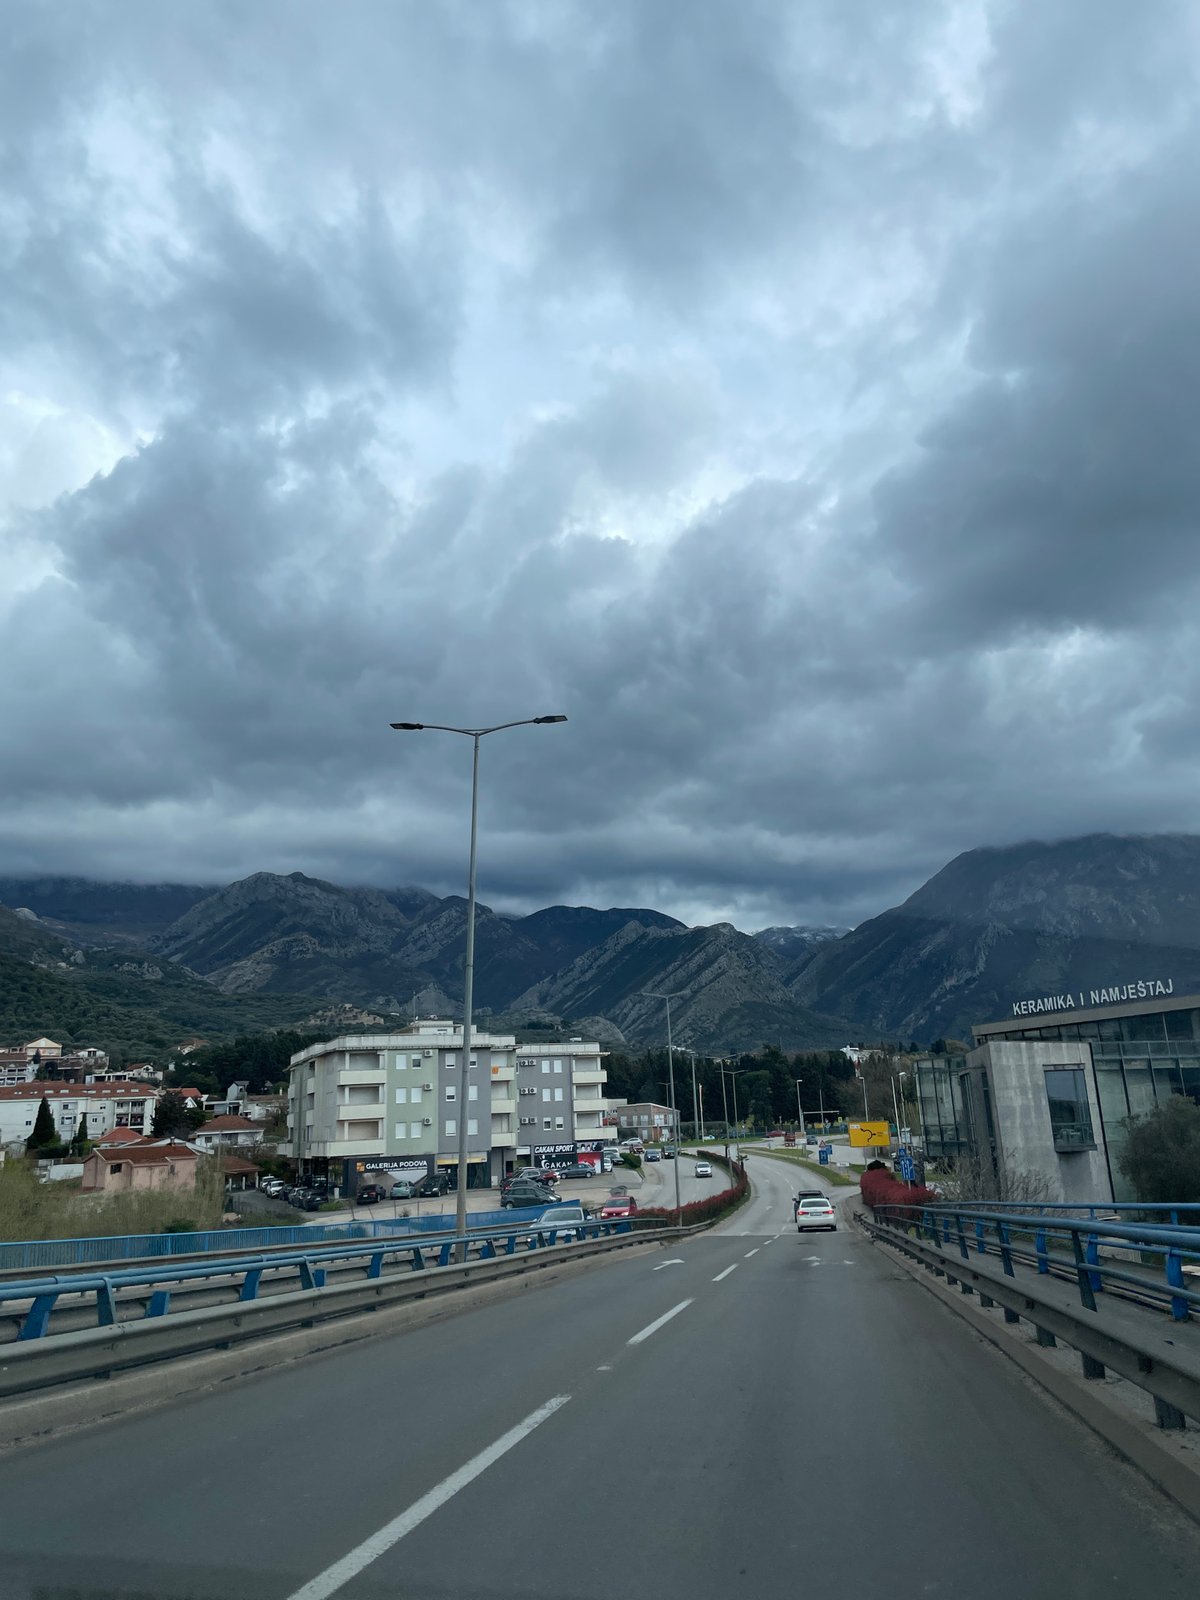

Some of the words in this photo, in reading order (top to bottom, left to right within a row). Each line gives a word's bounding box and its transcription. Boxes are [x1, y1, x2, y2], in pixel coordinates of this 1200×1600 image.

[1012, 994, 1075, 1015] KERAMIKA
[1079, 992, 1084, 1006] I
[1090, 978, 1174, 1005] NAMJEŠTAJ
